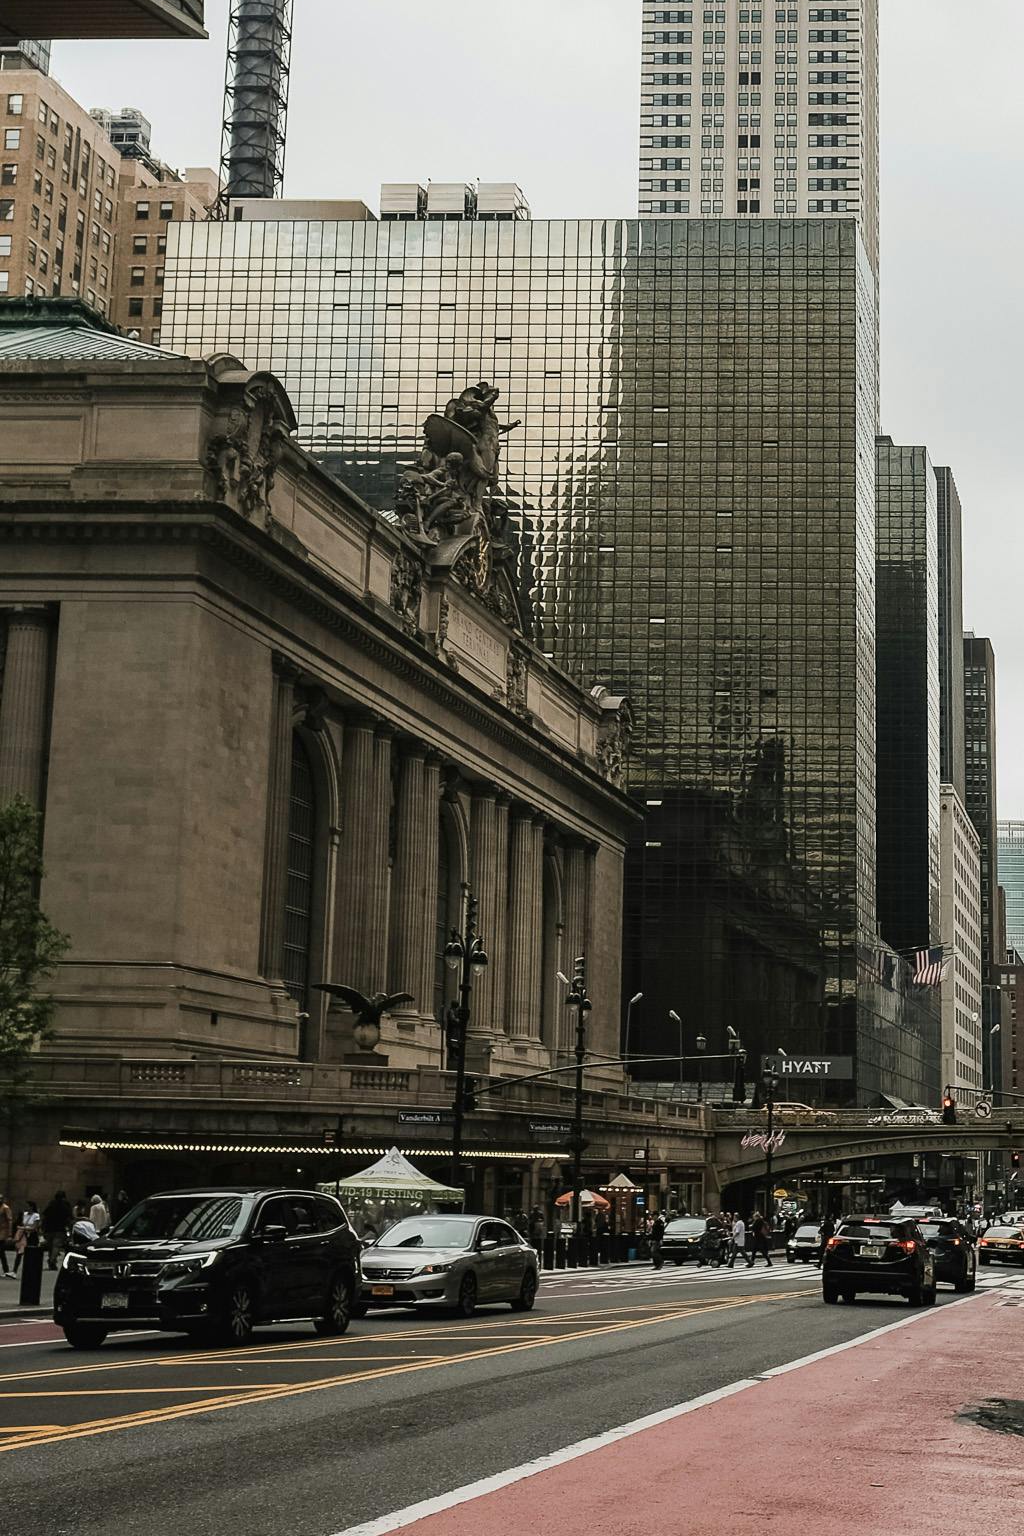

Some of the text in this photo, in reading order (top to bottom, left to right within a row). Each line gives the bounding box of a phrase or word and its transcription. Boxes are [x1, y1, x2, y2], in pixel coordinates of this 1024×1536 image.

[782, 1061, 831, 1074] HYATT
[400, 1114, 435, 1122] Vanderbilt
[321, 1186, 424, 1199] COVID-19 TESTING
